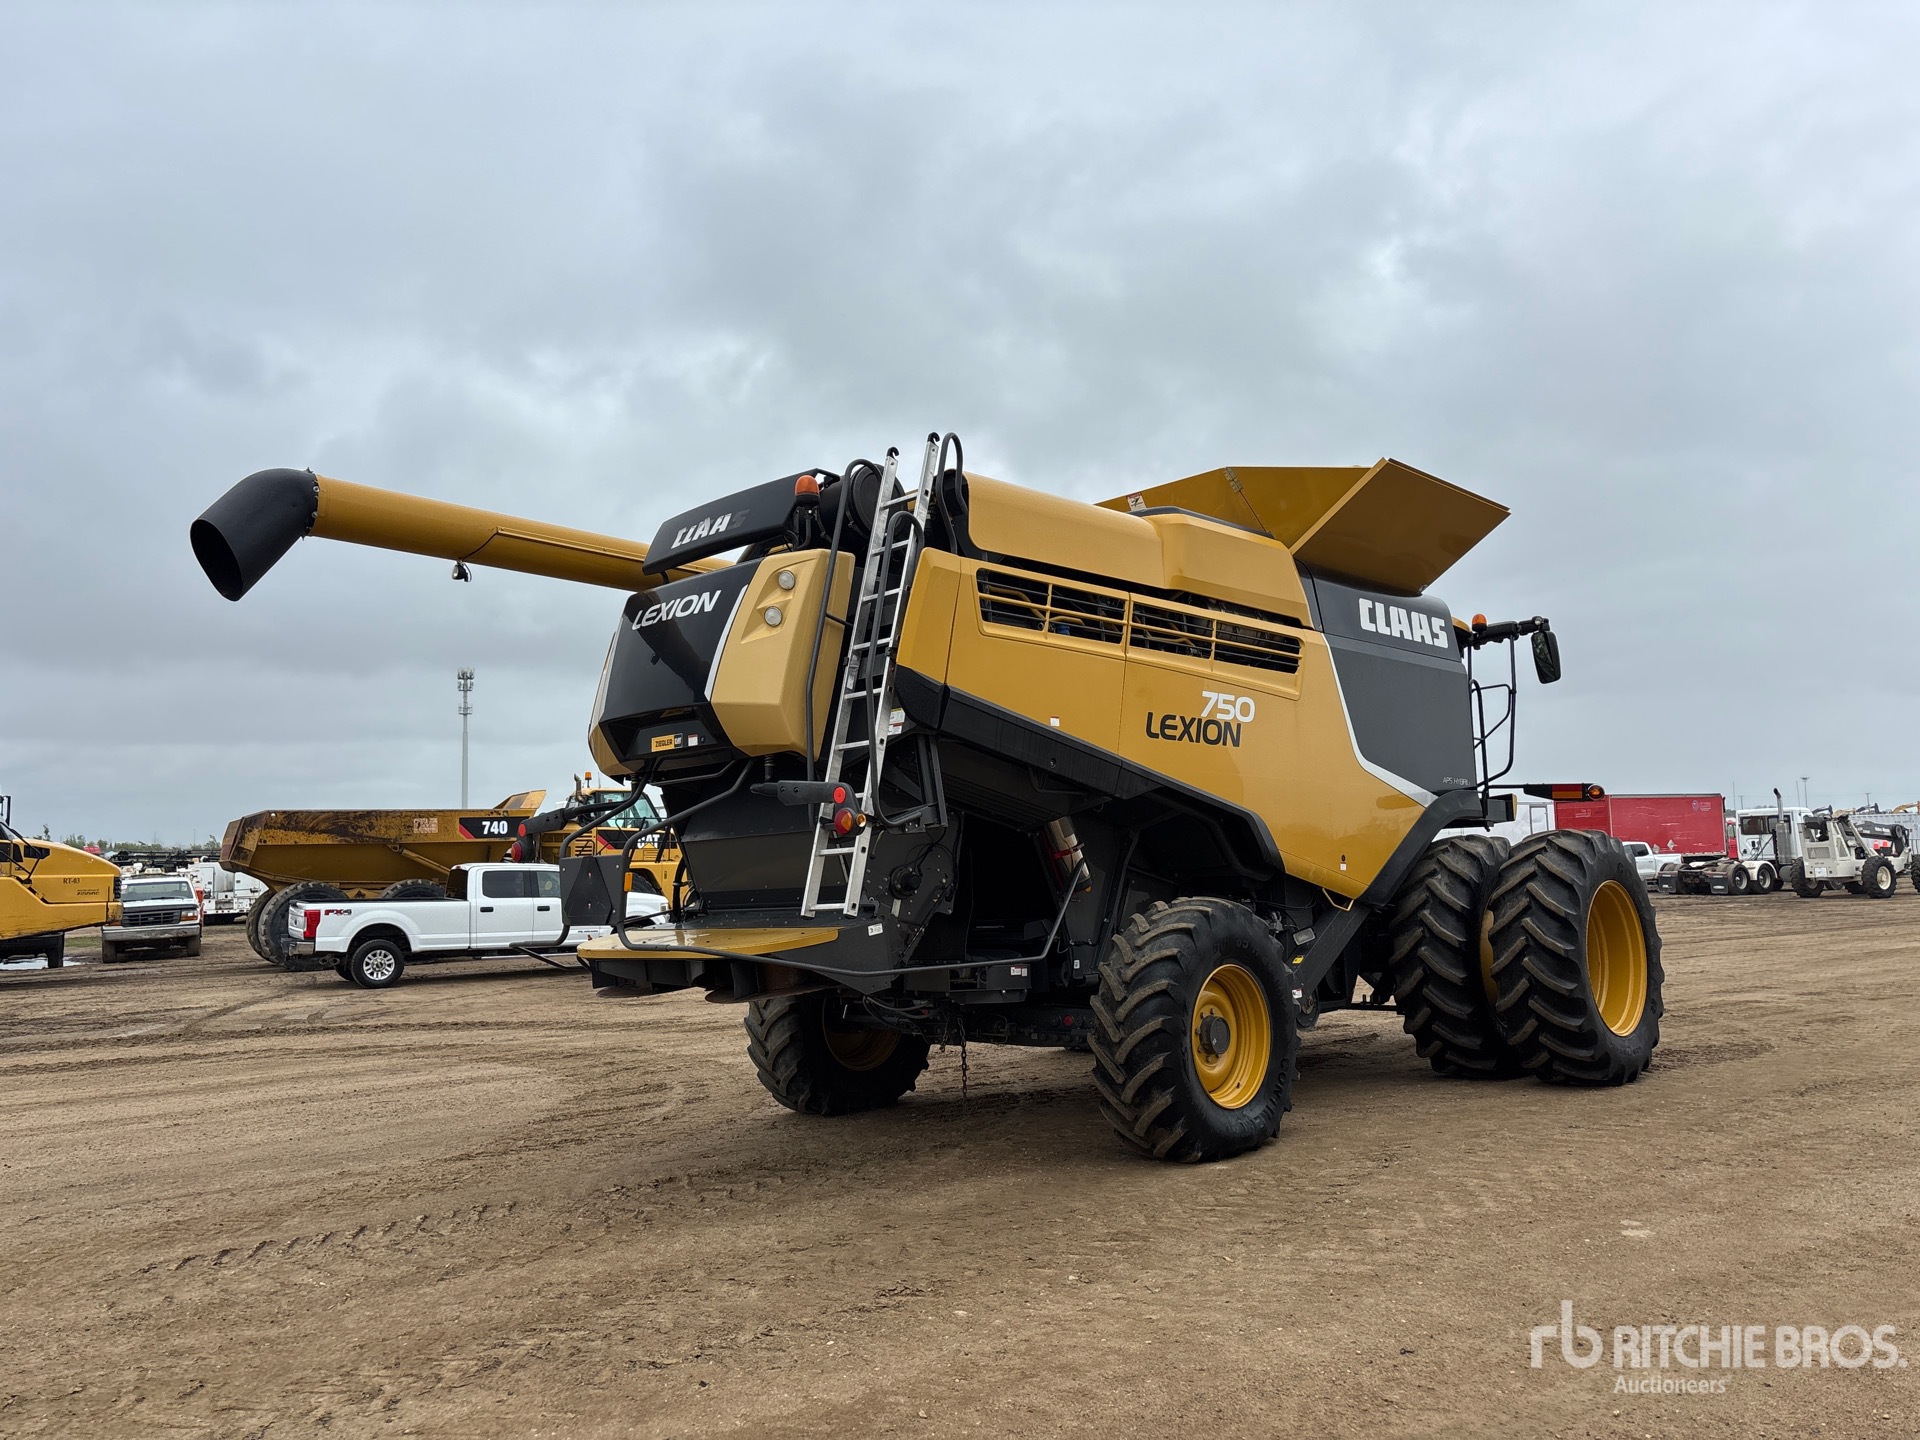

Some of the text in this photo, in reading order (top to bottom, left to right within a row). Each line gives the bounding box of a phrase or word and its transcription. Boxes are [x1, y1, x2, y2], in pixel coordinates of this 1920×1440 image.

[631, 589, 722, 631] LEXION
[1359, 598, 1449, 649] CLAAS
[1201, 690, 1255, 722] 750
[1145, 711, 1242, 748] LEXION
[655, 739, 673, 748] ZIEGLER
[1442, 776, 1453, 785] APS
[482, 820, 508, 835] 740
[637, 834, 660, 849] CAT
